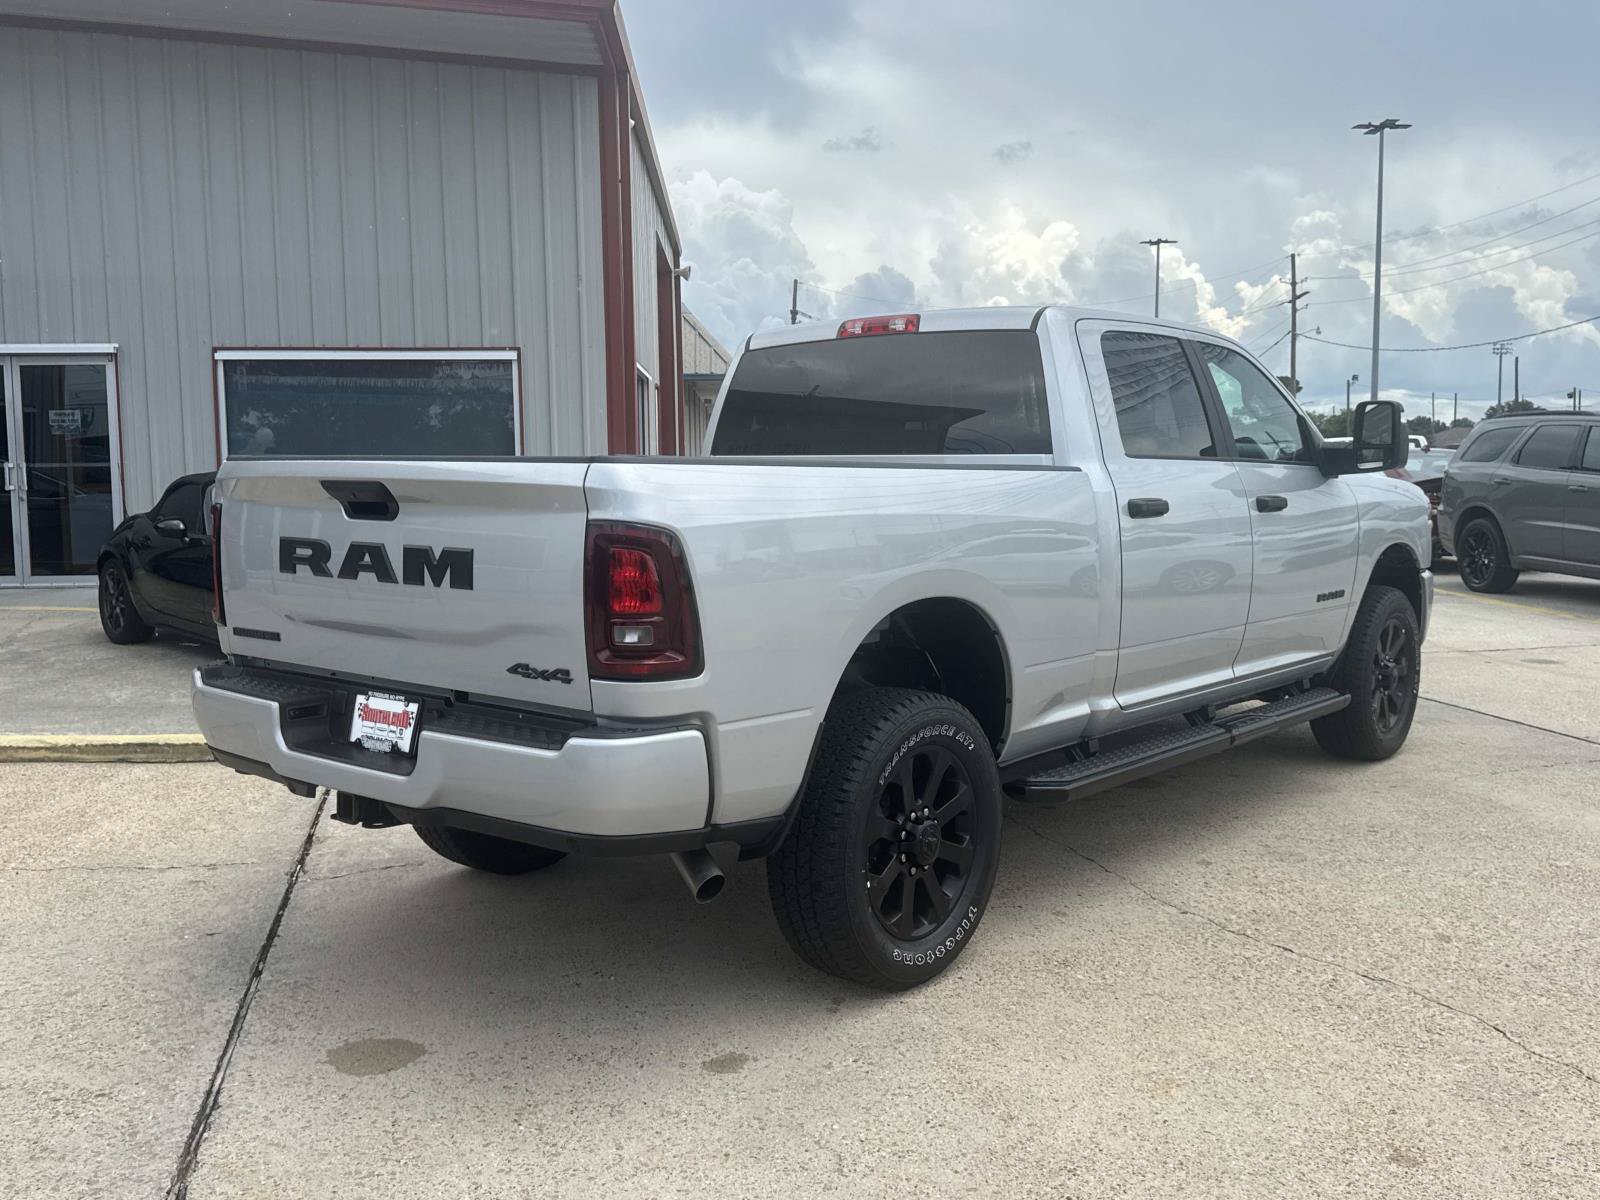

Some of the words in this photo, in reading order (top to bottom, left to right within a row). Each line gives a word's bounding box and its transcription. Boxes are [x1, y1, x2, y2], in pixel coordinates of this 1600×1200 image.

[279, 536, 474, 591] RAM
[362, 703, 410, 729] SOUTHLAND
[879, 724, 957, 786] TRANSFORCE
